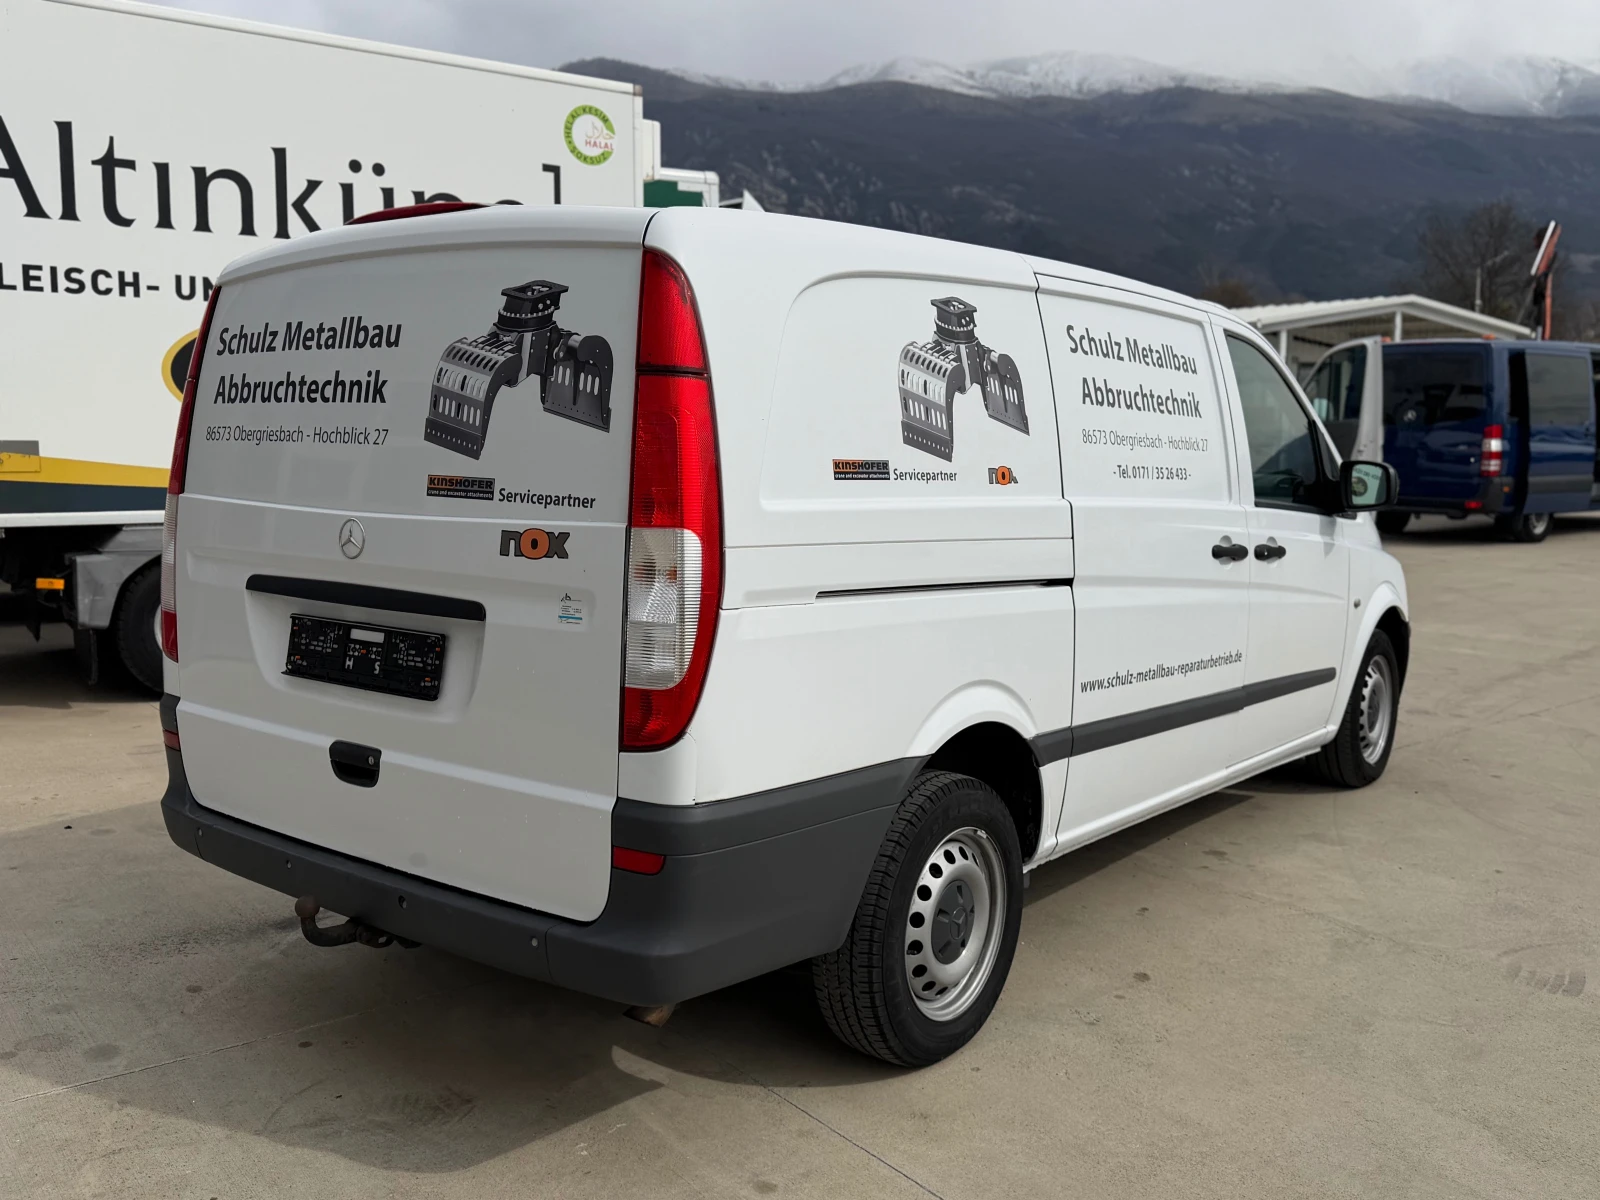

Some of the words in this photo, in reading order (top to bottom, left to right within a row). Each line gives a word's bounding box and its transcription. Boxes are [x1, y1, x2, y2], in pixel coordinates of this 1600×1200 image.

[585, 139, 614, 151] HALAL
[216, 322, 279, 356] Schulz
[281, 316, 402, 351] Metallbau
[1066, 324, 1125, 362] Schulz
[1125, 336, 1198, 375] Metallbau
[213, 370, 388, 404] Abbruchtechnik
[1082, 376, 1202, 419] Abbruchtechnik
[205, 426, 231, 441] 86573
[233, 425, 303, 446] Obergriesbach
[312, 426, 370, 445] Hochblick
[372, 428, 389, 446] 27
[1081, 428, 1107, 445] 86573
[1109, 430, 1163, 451] Obergriesbach
[1167, 436, 1200, 452] Hochblick
[1200, 438, 1208, 452] 27
[834, 461, 889, 471] KINSHOFER
[893, 468, 958, 484] Servicepartner
[1117, 464, 1131, 479] Tel.
[1132, 466, 1149, 479] 0171
[429, 476, 494, 490] KINSHOFER
[498, 488, 596, 509] Servicepartner
[1080, 649, 1243, 693] www.schulz-metallbau-reparaturbetrieb.de
